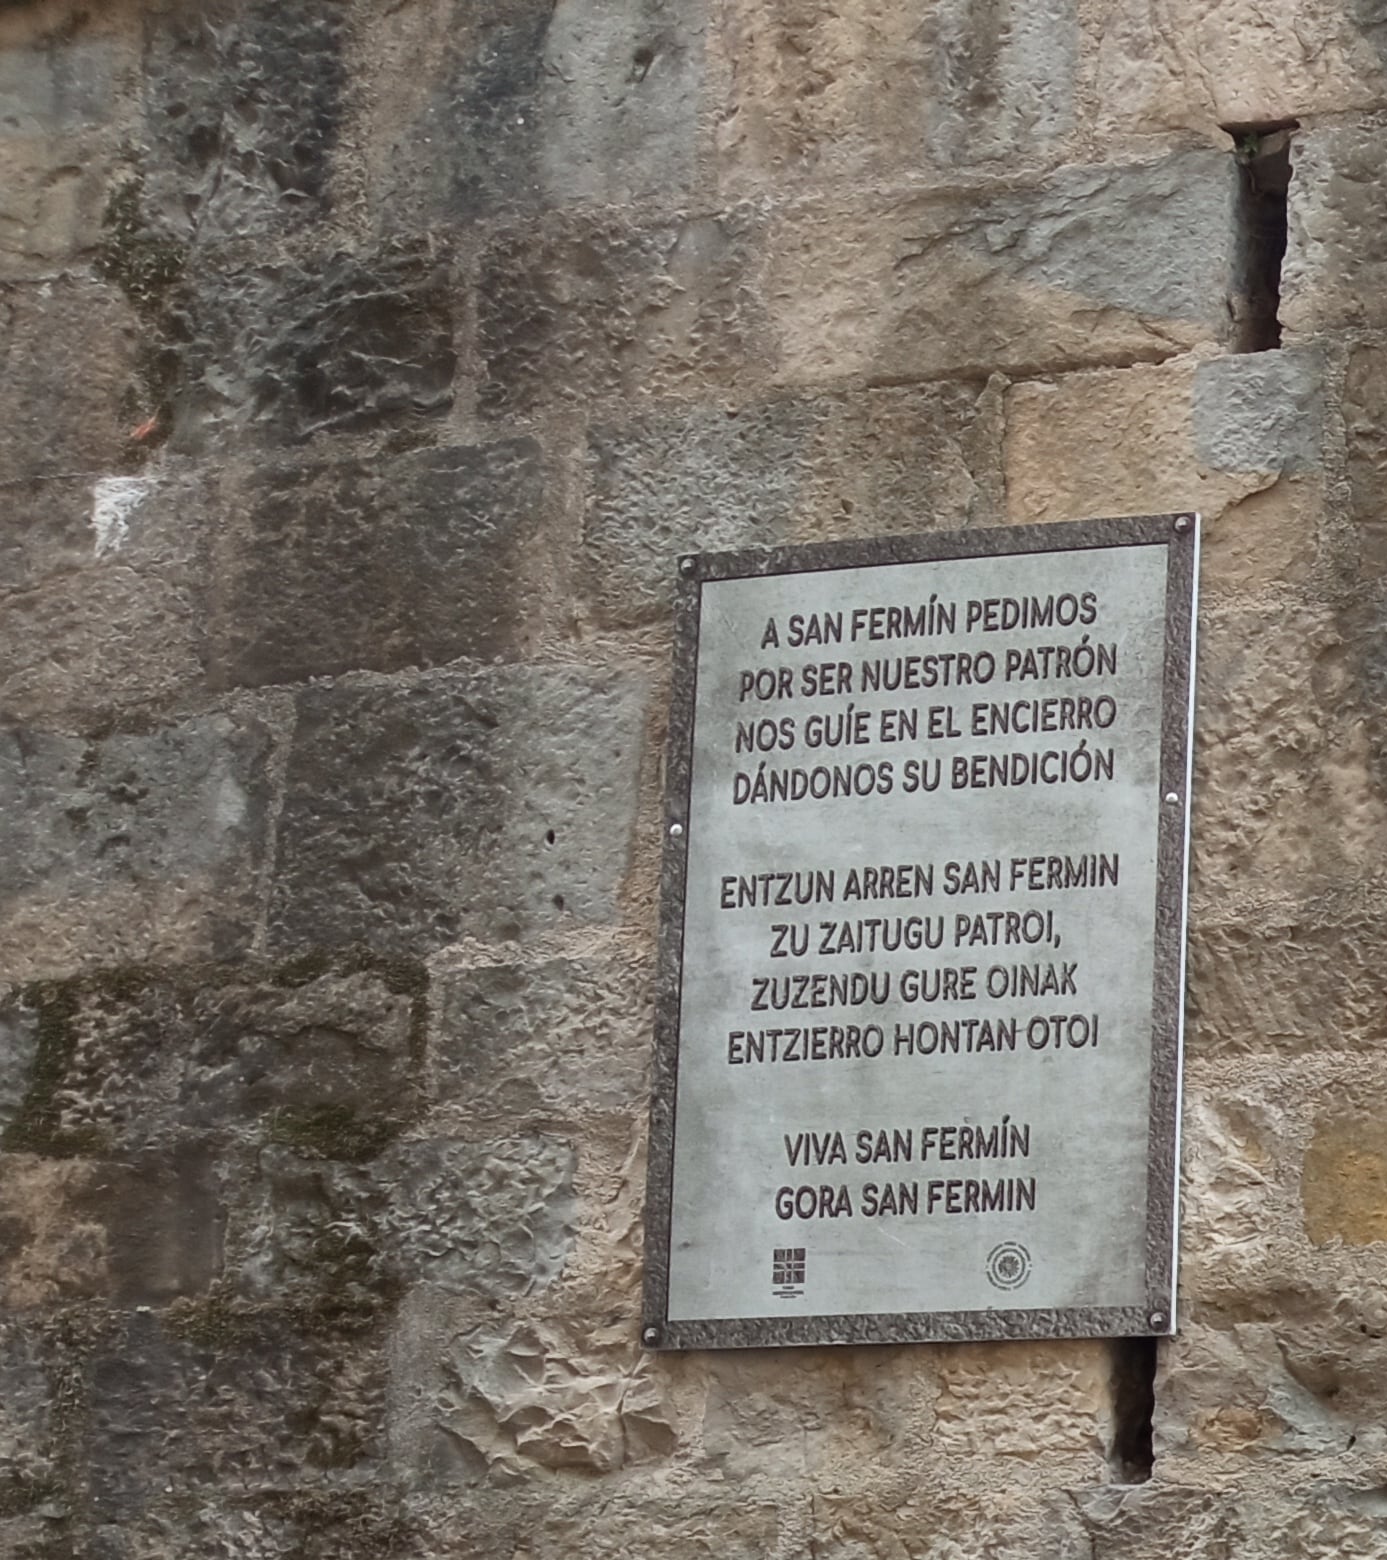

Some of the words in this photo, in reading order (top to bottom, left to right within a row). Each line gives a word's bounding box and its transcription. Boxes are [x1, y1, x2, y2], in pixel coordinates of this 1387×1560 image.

[761, 617, 779, 649] A
[787, 612, 842, 645] SAN
[851, 594, 956, 642] FERMÍN
[966, 592, 1097, 632] PEDIMOS
[740, 668, 793, 702] POR
[801, 662, 853, 697] SER
[861, 652, 995, 692] NUESTRO
[1005, 635, 1117, 681] PATRÓN
[735, 718, 795, 753] NOS
[805, 703, 870, 748] GUÍE
[881, 709, 917, 742] EN
[928, 706, 961, 738] EL
[972, 695, 1116, 736] ENCIERRO
[733, 763, 893, 804] DÁNDONOS
[902, 758, 942, 792] SU
[951, 739, 1114, 789] BENDICIÓN
[720, 869, 834, 909] ENTZUN
[843, 864, 934, 901] ARREN
[943, 860, 1000, 894] SAN
[1010, 853, 1119, 890] FERMIN
[770, 923, 808, 958] ZU
[819, 915, 944, 954] ZAITUGU
[954, 909, 1062, 948] PATROI,
[751, 971, 890, 1011] ZUZENDU
[900, 967, 977, 1001] GURE
[987, 962, 1078, 999] OINAK
[728, 1024, 883, 1064] ENTZIERRO
[894, 1018, 1017, 1056] HONTAN
[1027, 1014, 1098, 1050] OTOI
[784, 1132, 847, 1167] VIVA
[855, 1129, 913, 1164] SAN
[920, 1115, 1030, 1161] FERMÍN
[775, 1184, 853, 1220] GORA
[861, 1183, 918, 1216] SAN
[927, 1177, 1036, 1215] FERMIN
